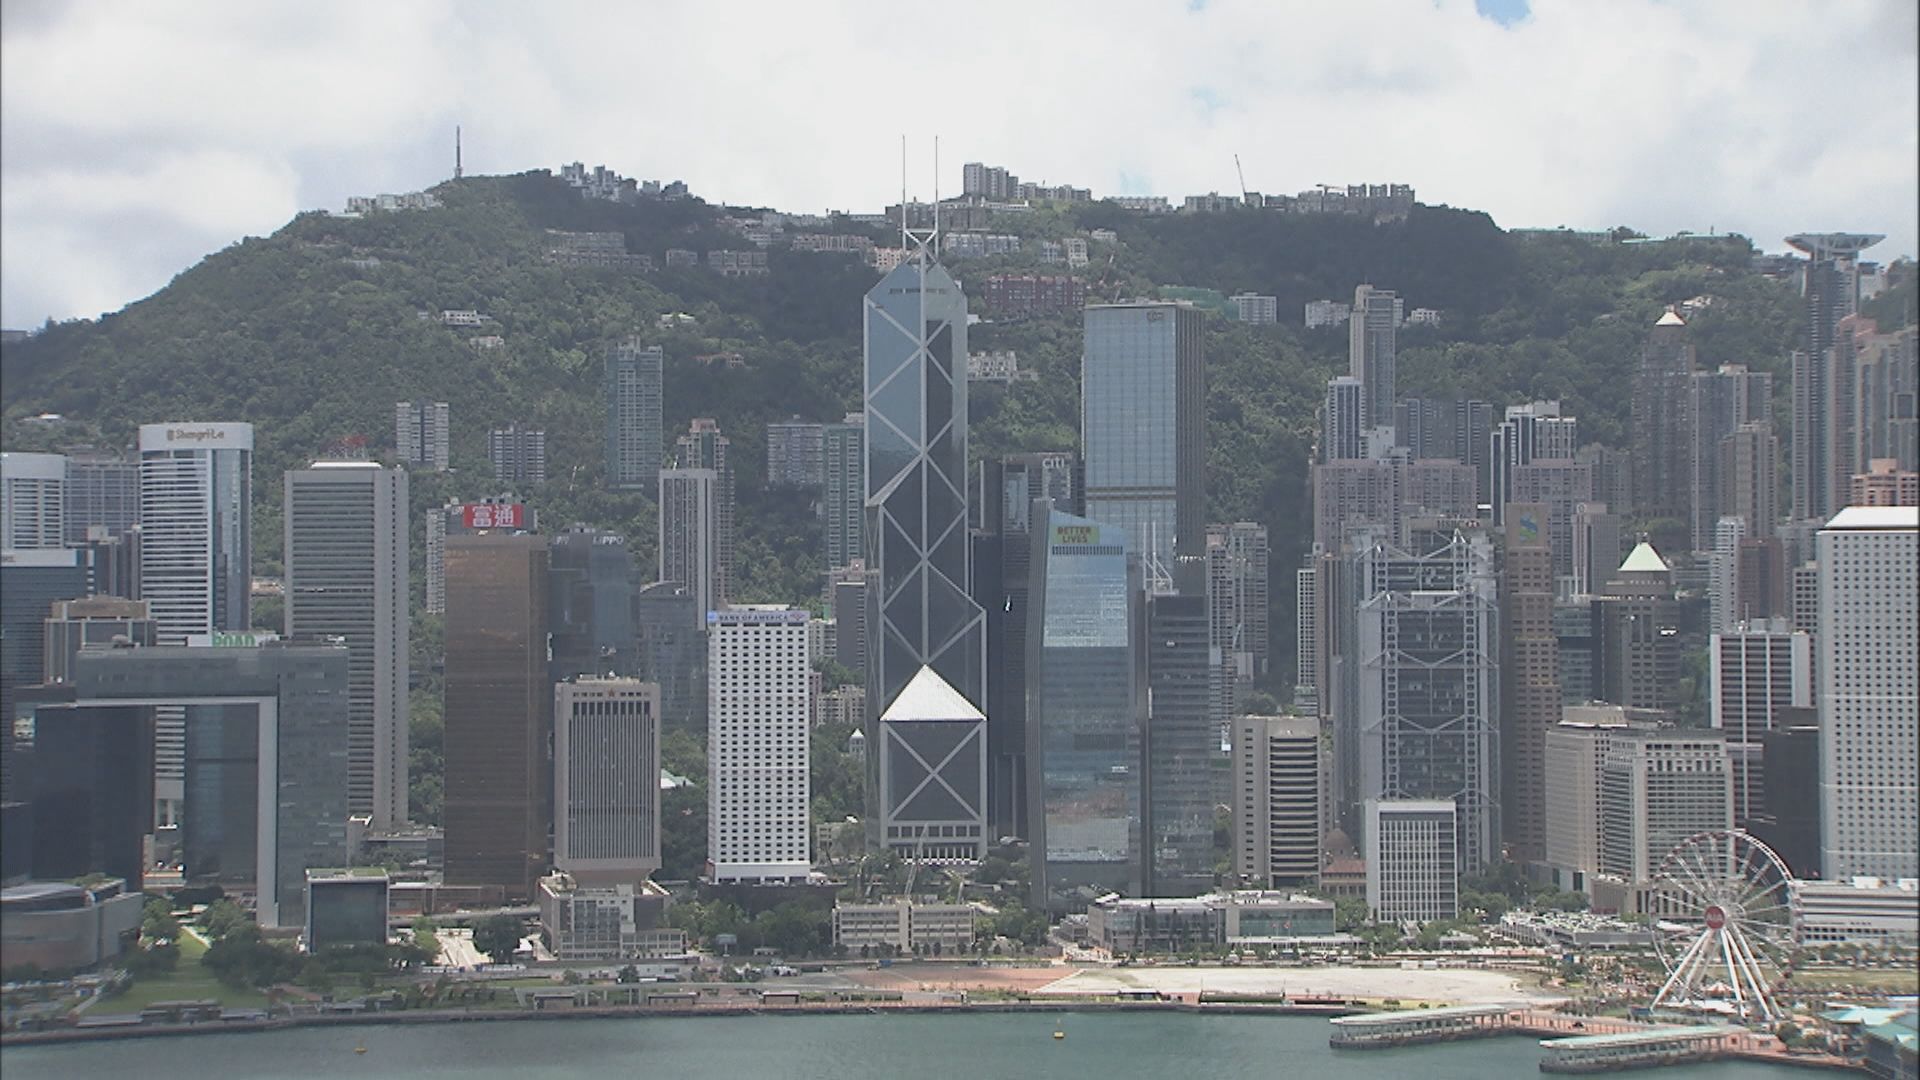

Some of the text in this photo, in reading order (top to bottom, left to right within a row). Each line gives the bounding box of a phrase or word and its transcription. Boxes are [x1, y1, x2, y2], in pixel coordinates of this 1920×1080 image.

[1042, 456, 1064, 469] citi
[472, 505, 514, 527] 富通
[1062, 535, 1088, 543] LIVES
